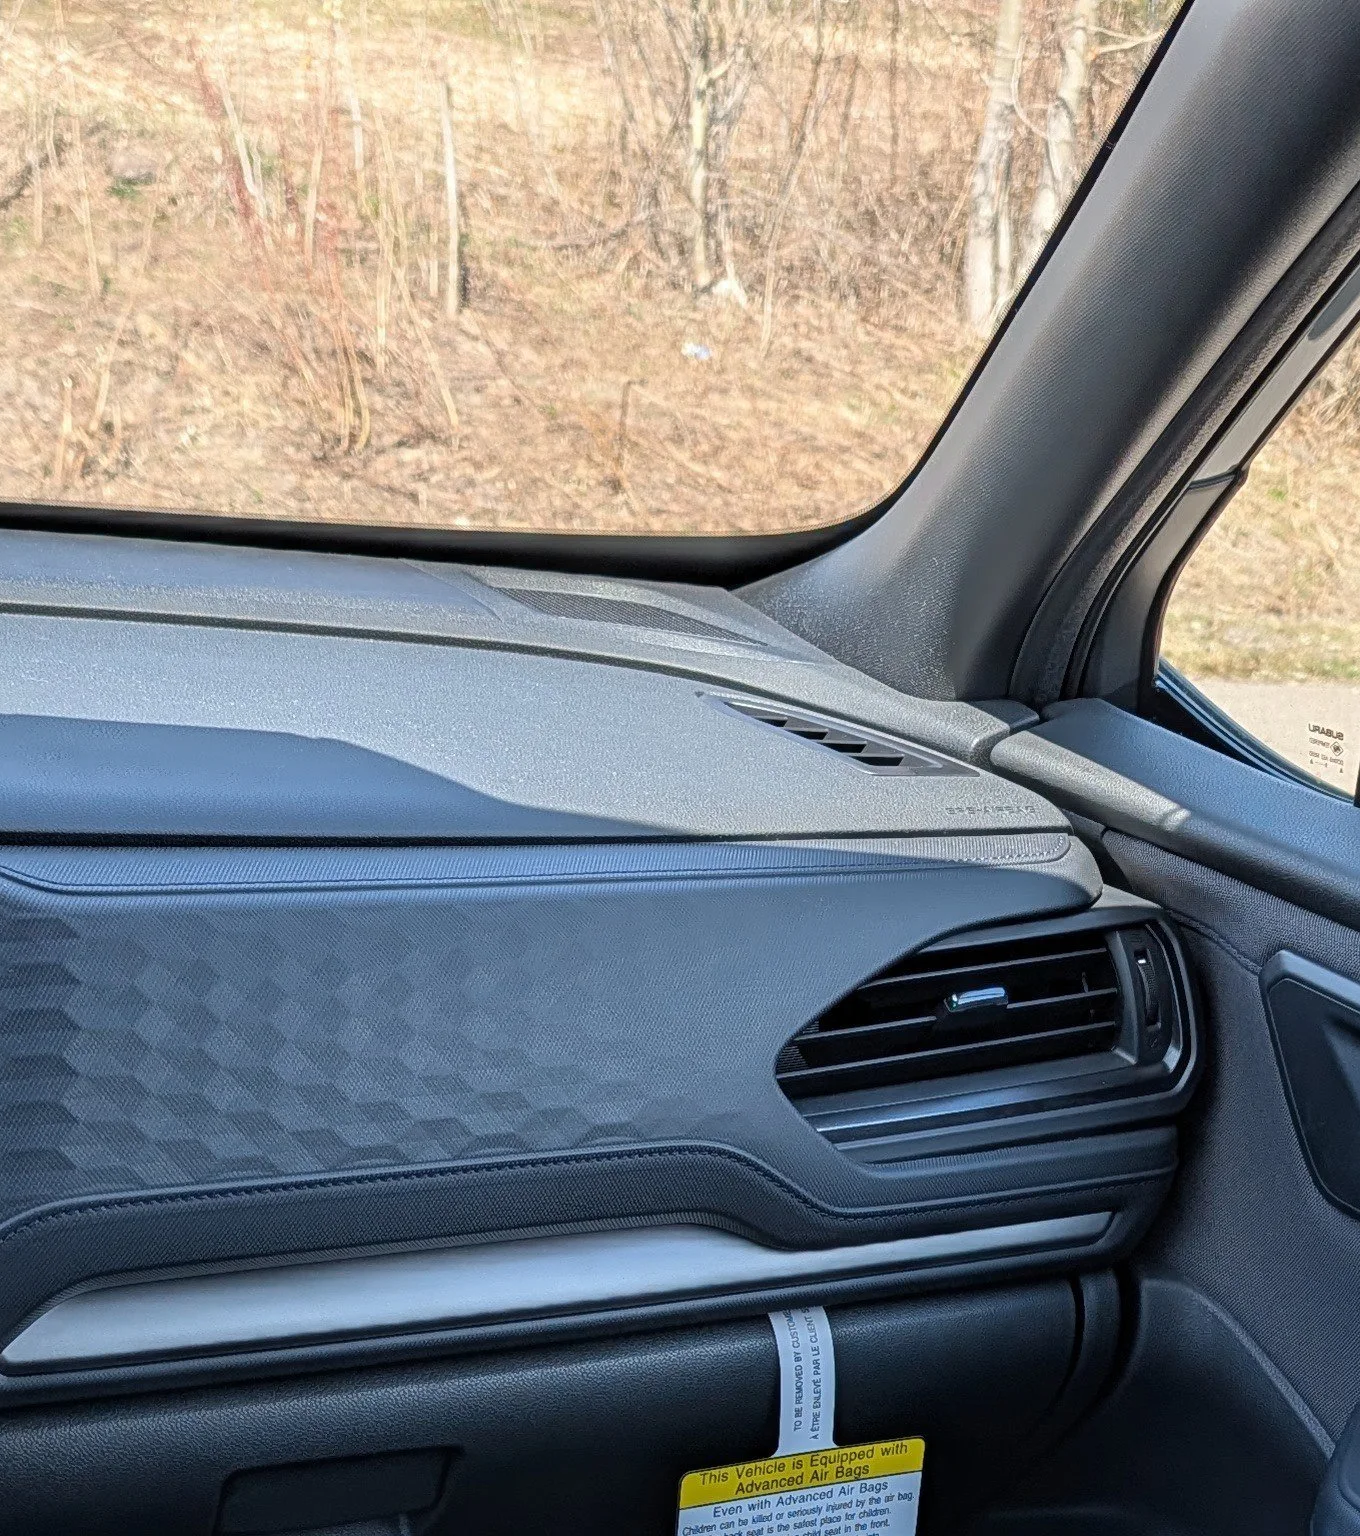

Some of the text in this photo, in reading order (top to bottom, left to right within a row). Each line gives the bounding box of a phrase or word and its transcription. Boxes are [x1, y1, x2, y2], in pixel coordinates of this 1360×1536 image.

[805, 1317, 818, 1343] CLIENT
[811, 1345, 820, 1357] LE
[783, 1309, 803, 1431] TO BE REMOVED BY CUSTOME
[700, 1443, 908, 1485] This Vehicle is Equipped with
[735, 1463, 869, 1495] Advanced Air Bags
[682, 1524, 717, 1536] Children
[720, 1520, 735, 1530] can
[738, 1518, 748, 1527] be
[752, 1513, 772, 1524] killed
[776, 1512, 784, 1520] or
[787, 1505, 823, 1518] seriously
[826, 1500, 853, 1513] injured
[855, 1499, 866, 1509] by
[868, 1496, 881, 1506] the
[885, 1494, 895, 1503] air
[713, 1481, 888, 1518] Even with Advanced Air Bags
[746, 1527, 764, 1536] seat
[767, 1525, 774, 1534] is
[777, 1523, 790, 1533] the
[793, 1518, 817, 1530] safest
[820, 1514, 842, 1526] place
[845, 1512, 856, 1521] for
[824, 1527, 841, 1536] seat
[844, 1524, 851, 1532] in
[855, 1523, 867, 1531] the
